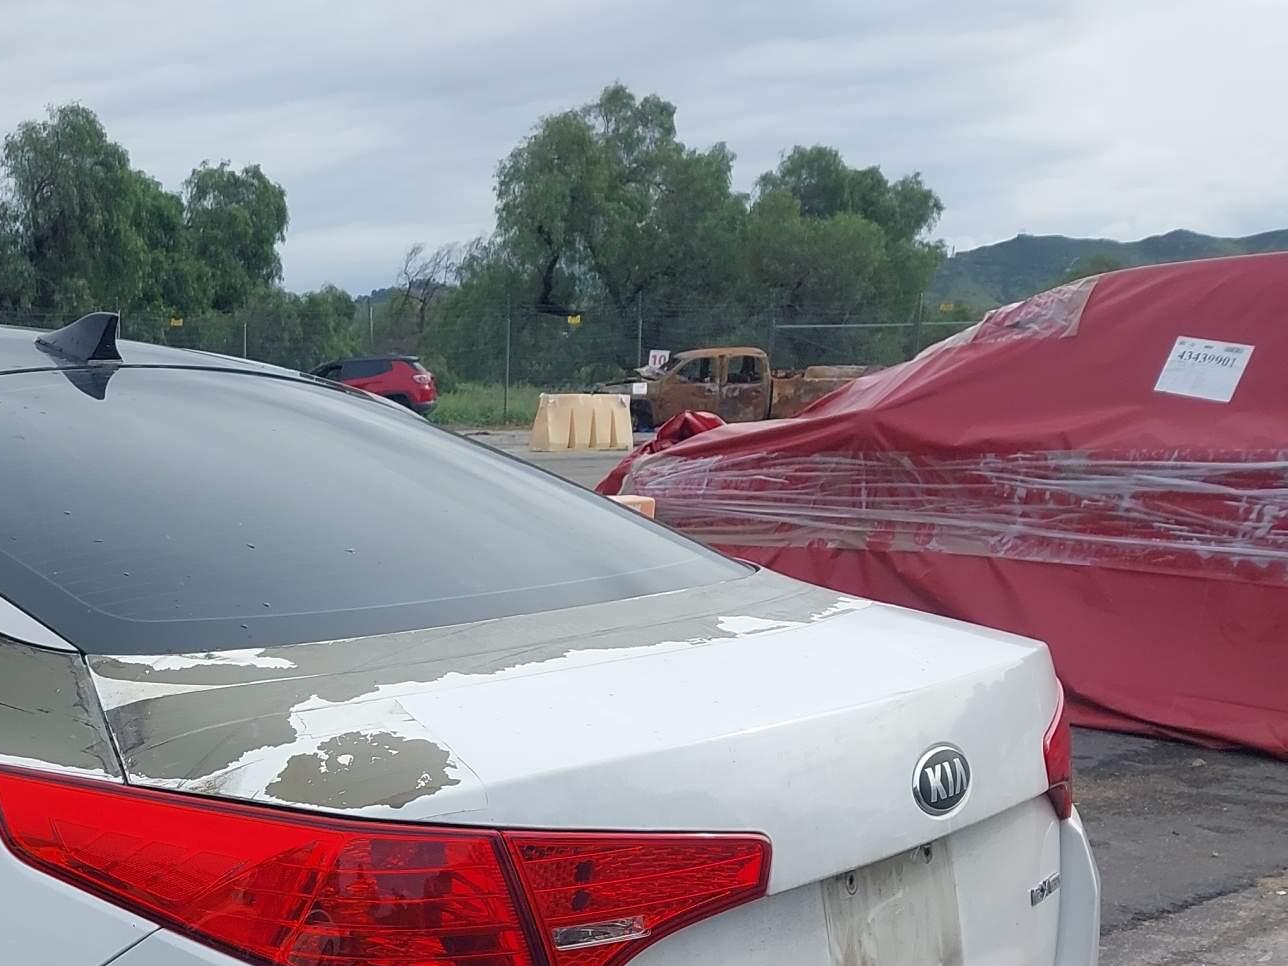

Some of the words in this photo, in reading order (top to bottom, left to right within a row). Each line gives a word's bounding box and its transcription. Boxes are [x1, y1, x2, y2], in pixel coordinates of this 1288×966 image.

[651, 354, 667, 367] 10
[1177, 350, 1237, 368] 43439901
[924, 757, 968, 803] KIA
